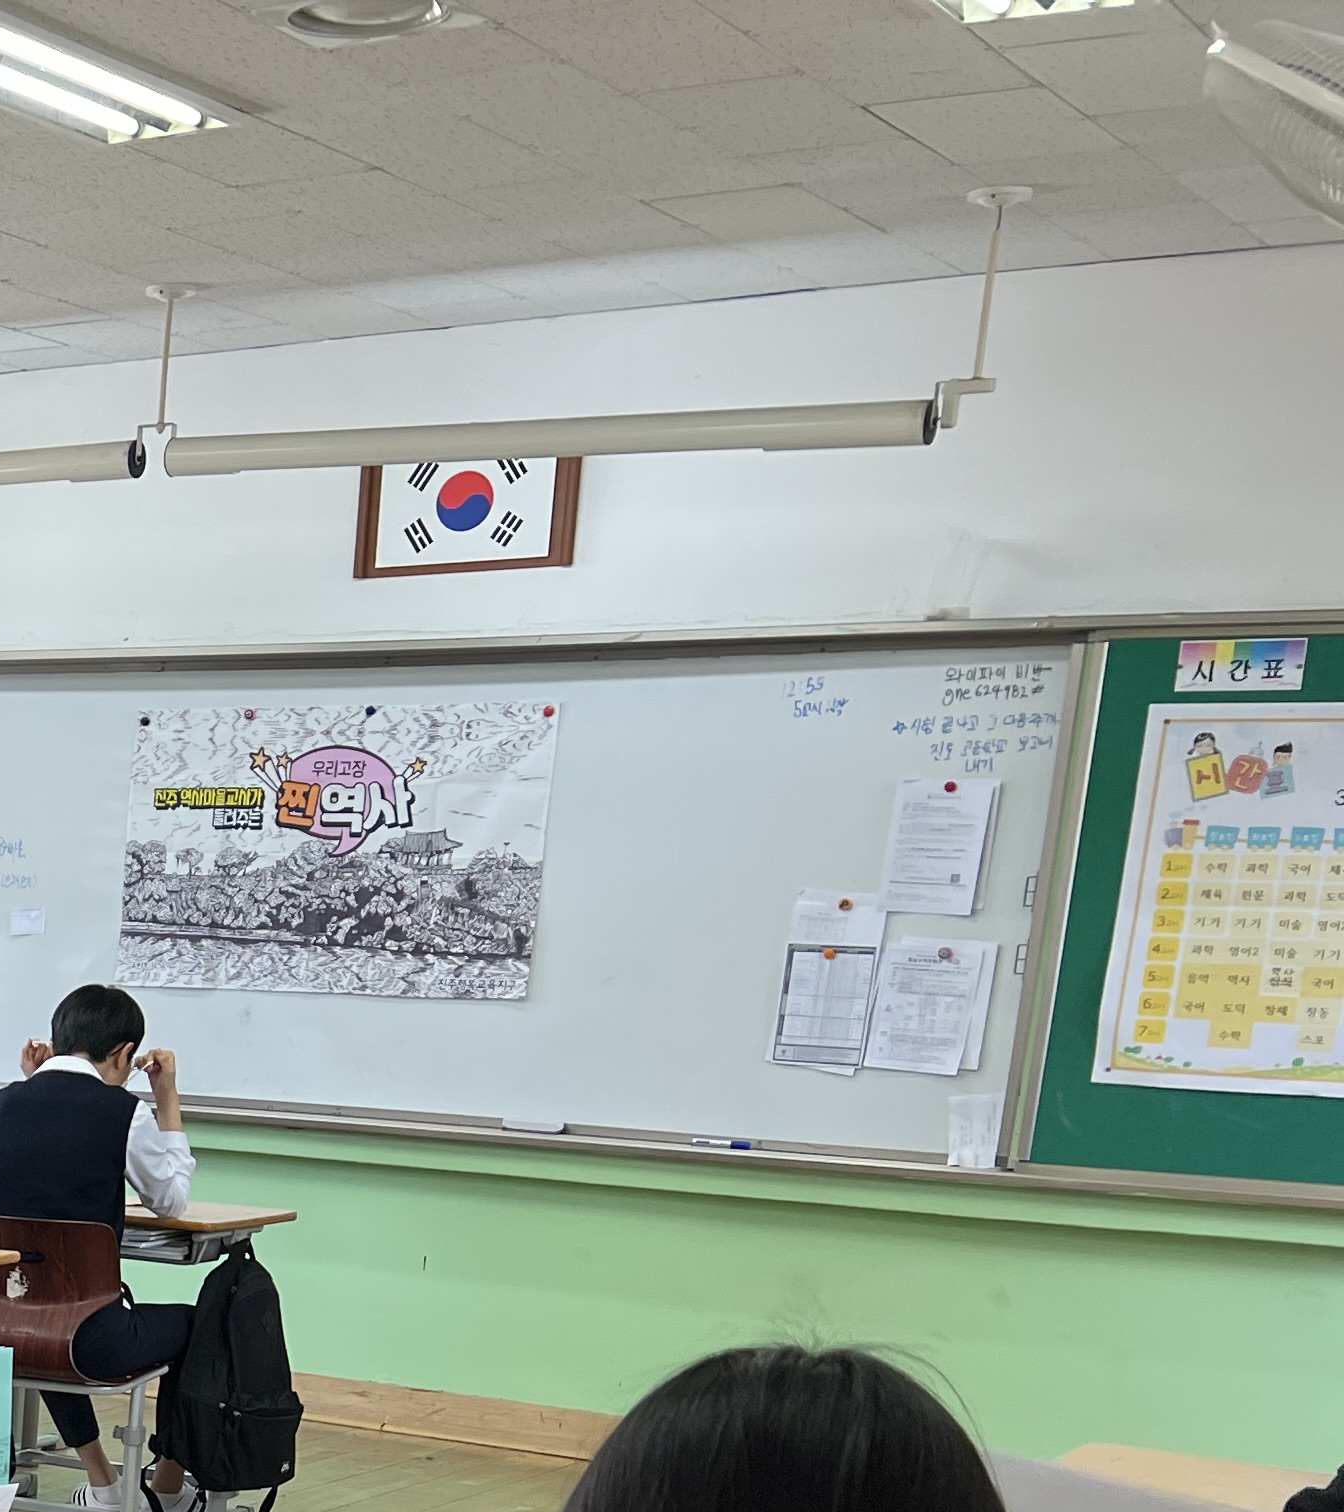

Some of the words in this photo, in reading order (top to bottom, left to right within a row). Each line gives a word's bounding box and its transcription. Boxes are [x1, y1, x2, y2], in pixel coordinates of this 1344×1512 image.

[945, 667, 1006, 682] 와이파이
[1015, 664, 1053, 682] 비번
[312, 760, 367, 778] 우리고장
[965, 757, 993, 773] 내기
[155, 788, 177, 807] 진주
[180, 788, 262, 807] 역사마을교사가
[213, 808, 262, 828] 들려주는
[1205, 862, 1228, 874] 수학
[1288, 863, 1311, 875] 국어
[1329, 863, 1344, 875] 체
[1279, 919, 1303, 931] 미술
[1311, 978, 1335, 989] 국어
[1183, 1001, 1205, 1013] 국어
